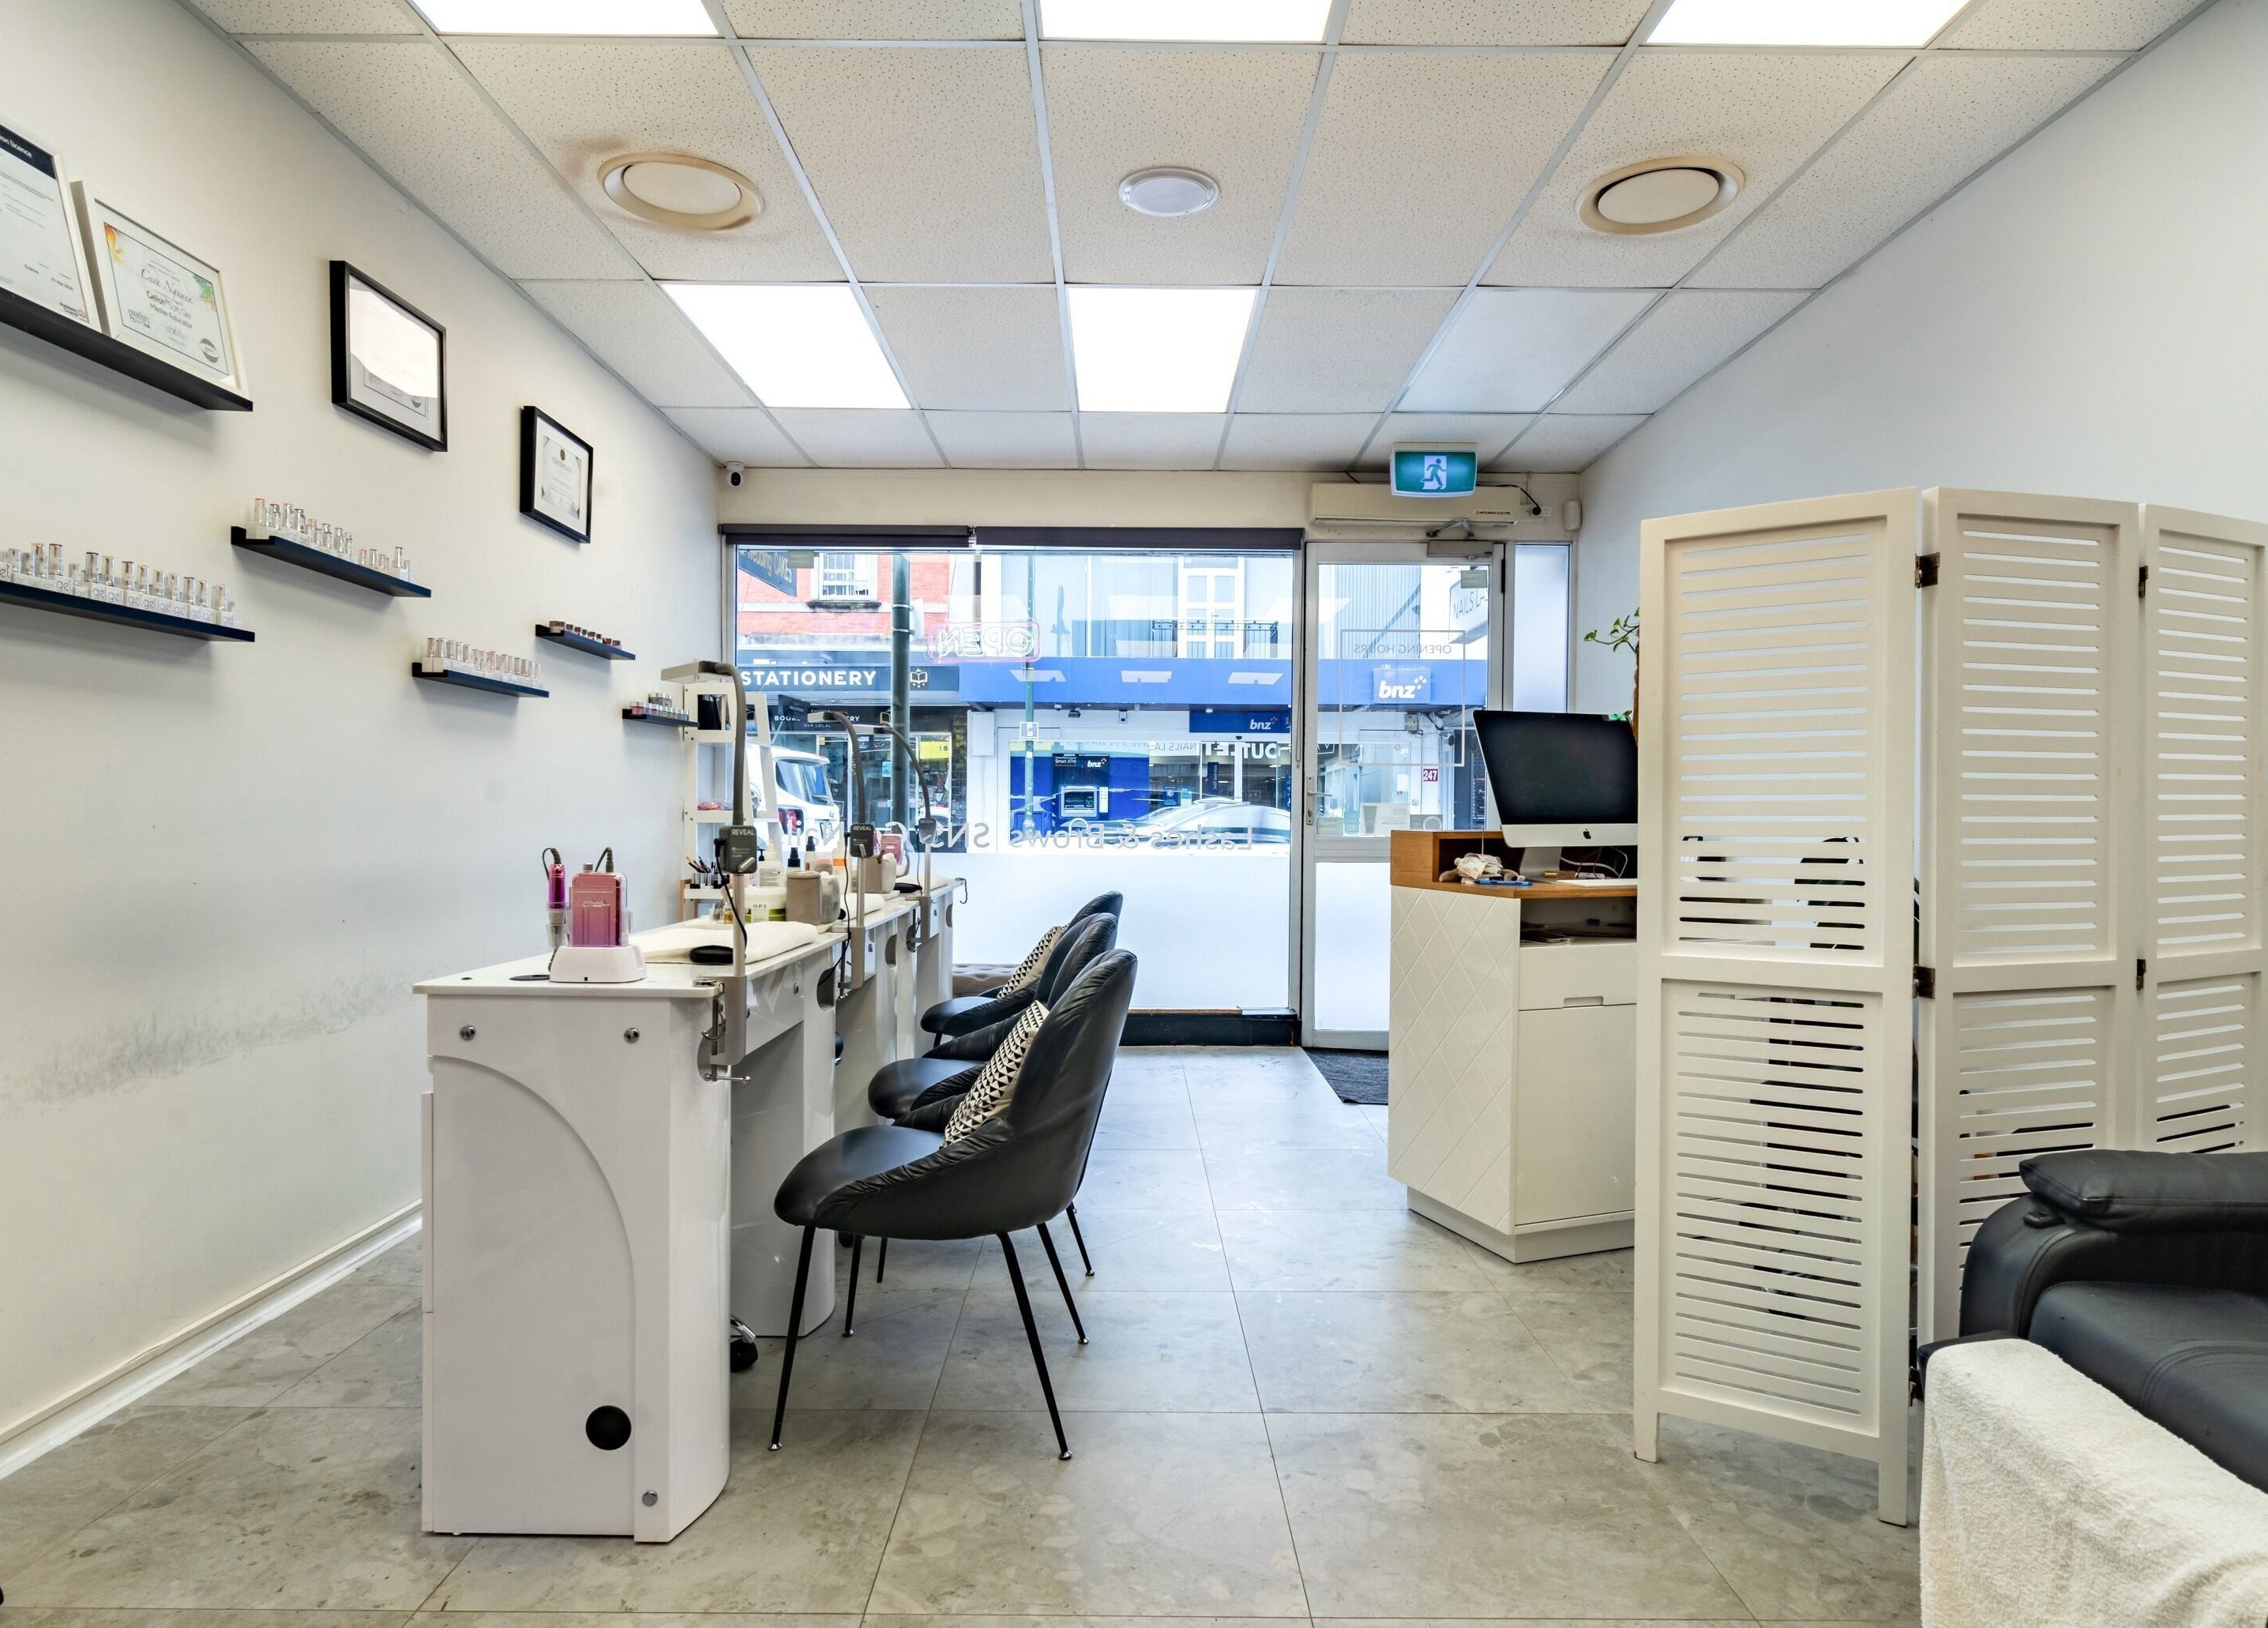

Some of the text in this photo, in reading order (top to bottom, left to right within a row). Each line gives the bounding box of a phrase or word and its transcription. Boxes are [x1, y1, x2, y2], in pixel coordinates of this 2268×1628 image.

[741, 671, 877, 686] STATIONERY
[1378, 680, 1417, 699] bnz
[1249, 719, 1271, 730] bnz
[1423, 769, 1438, 780] 247
